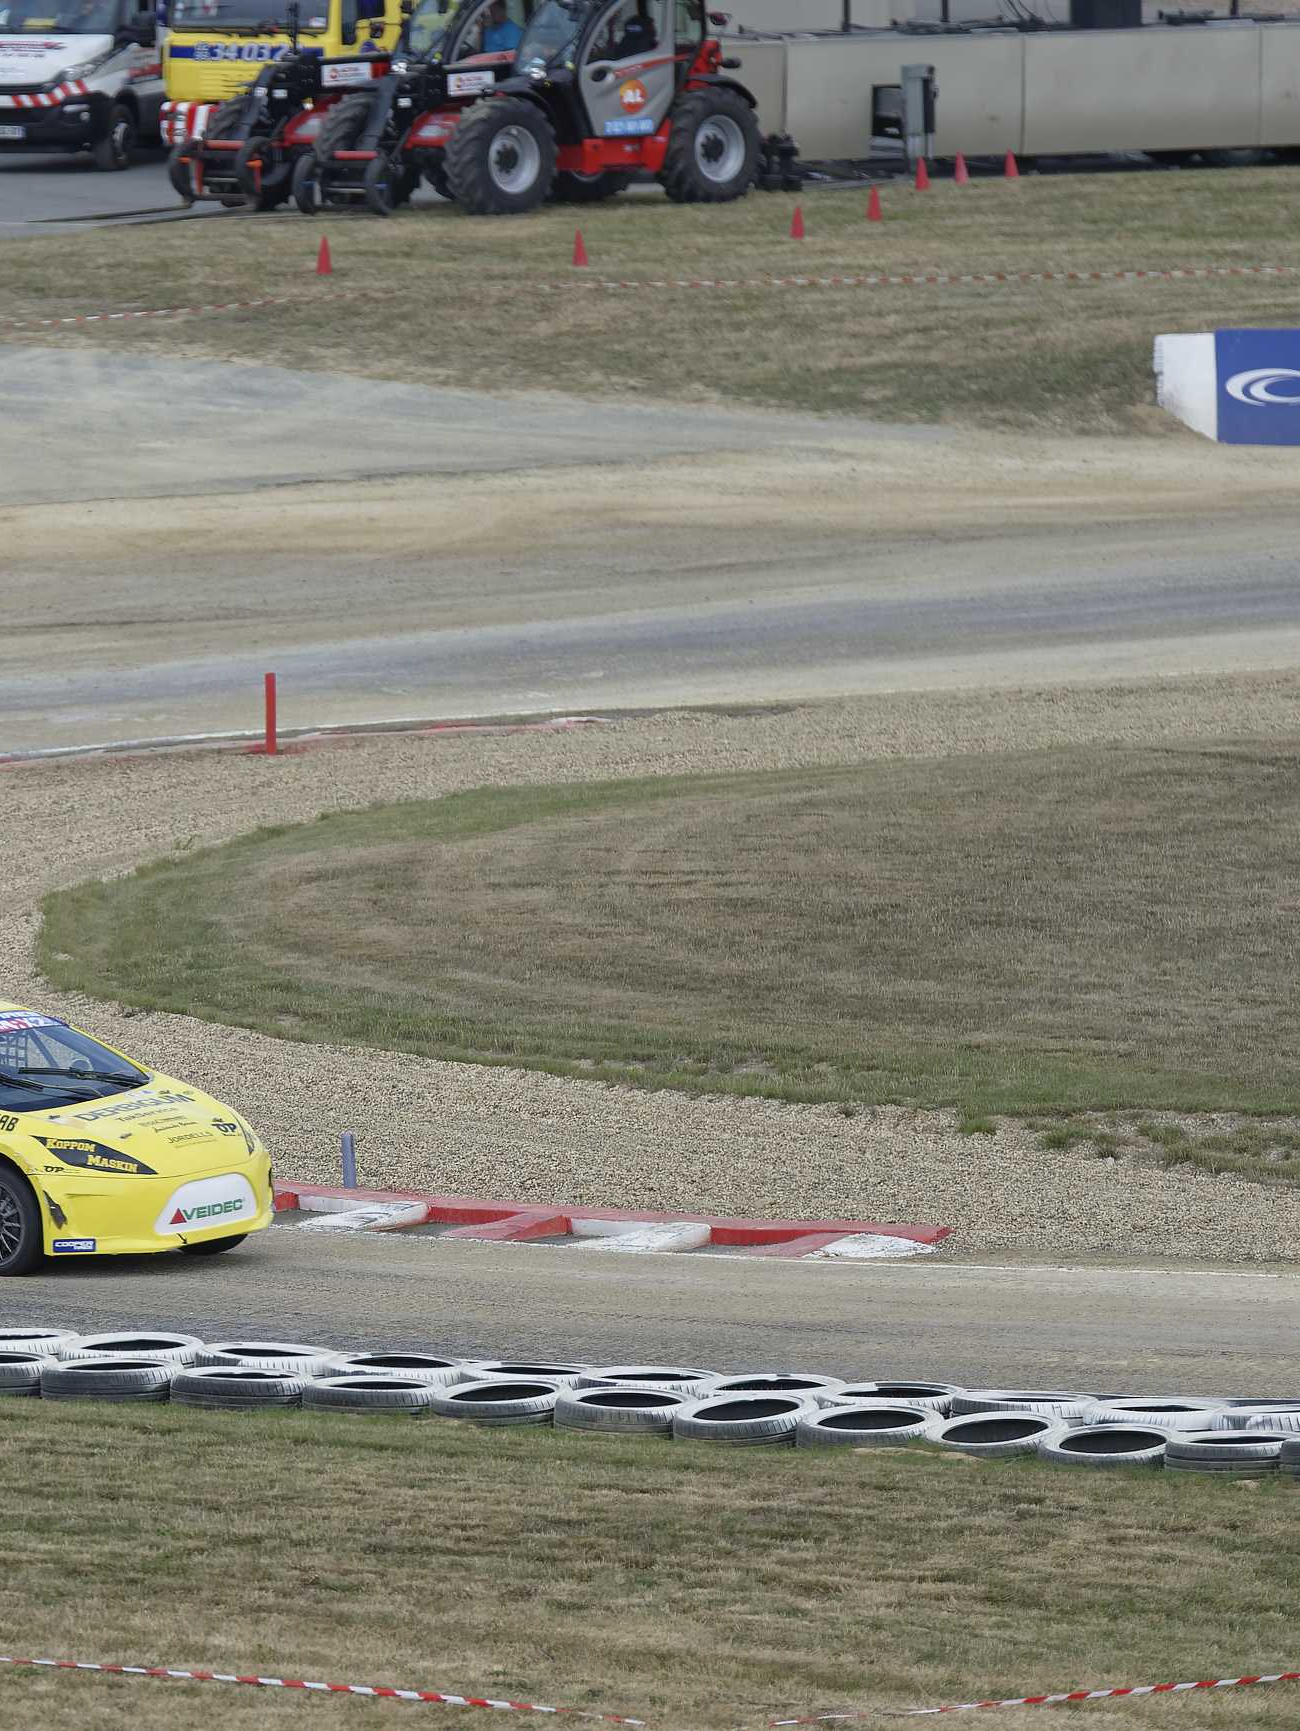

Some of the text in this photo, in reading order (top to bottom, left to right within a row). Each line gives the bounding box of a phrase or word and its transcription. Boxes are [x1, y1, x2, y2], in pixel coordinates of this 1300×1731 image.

[165, 1130, 214, 1144] JORDELLS
[182, 1198, 244, 1220] VEIDEC
[55, 1240, 93, 1249] COOPER
